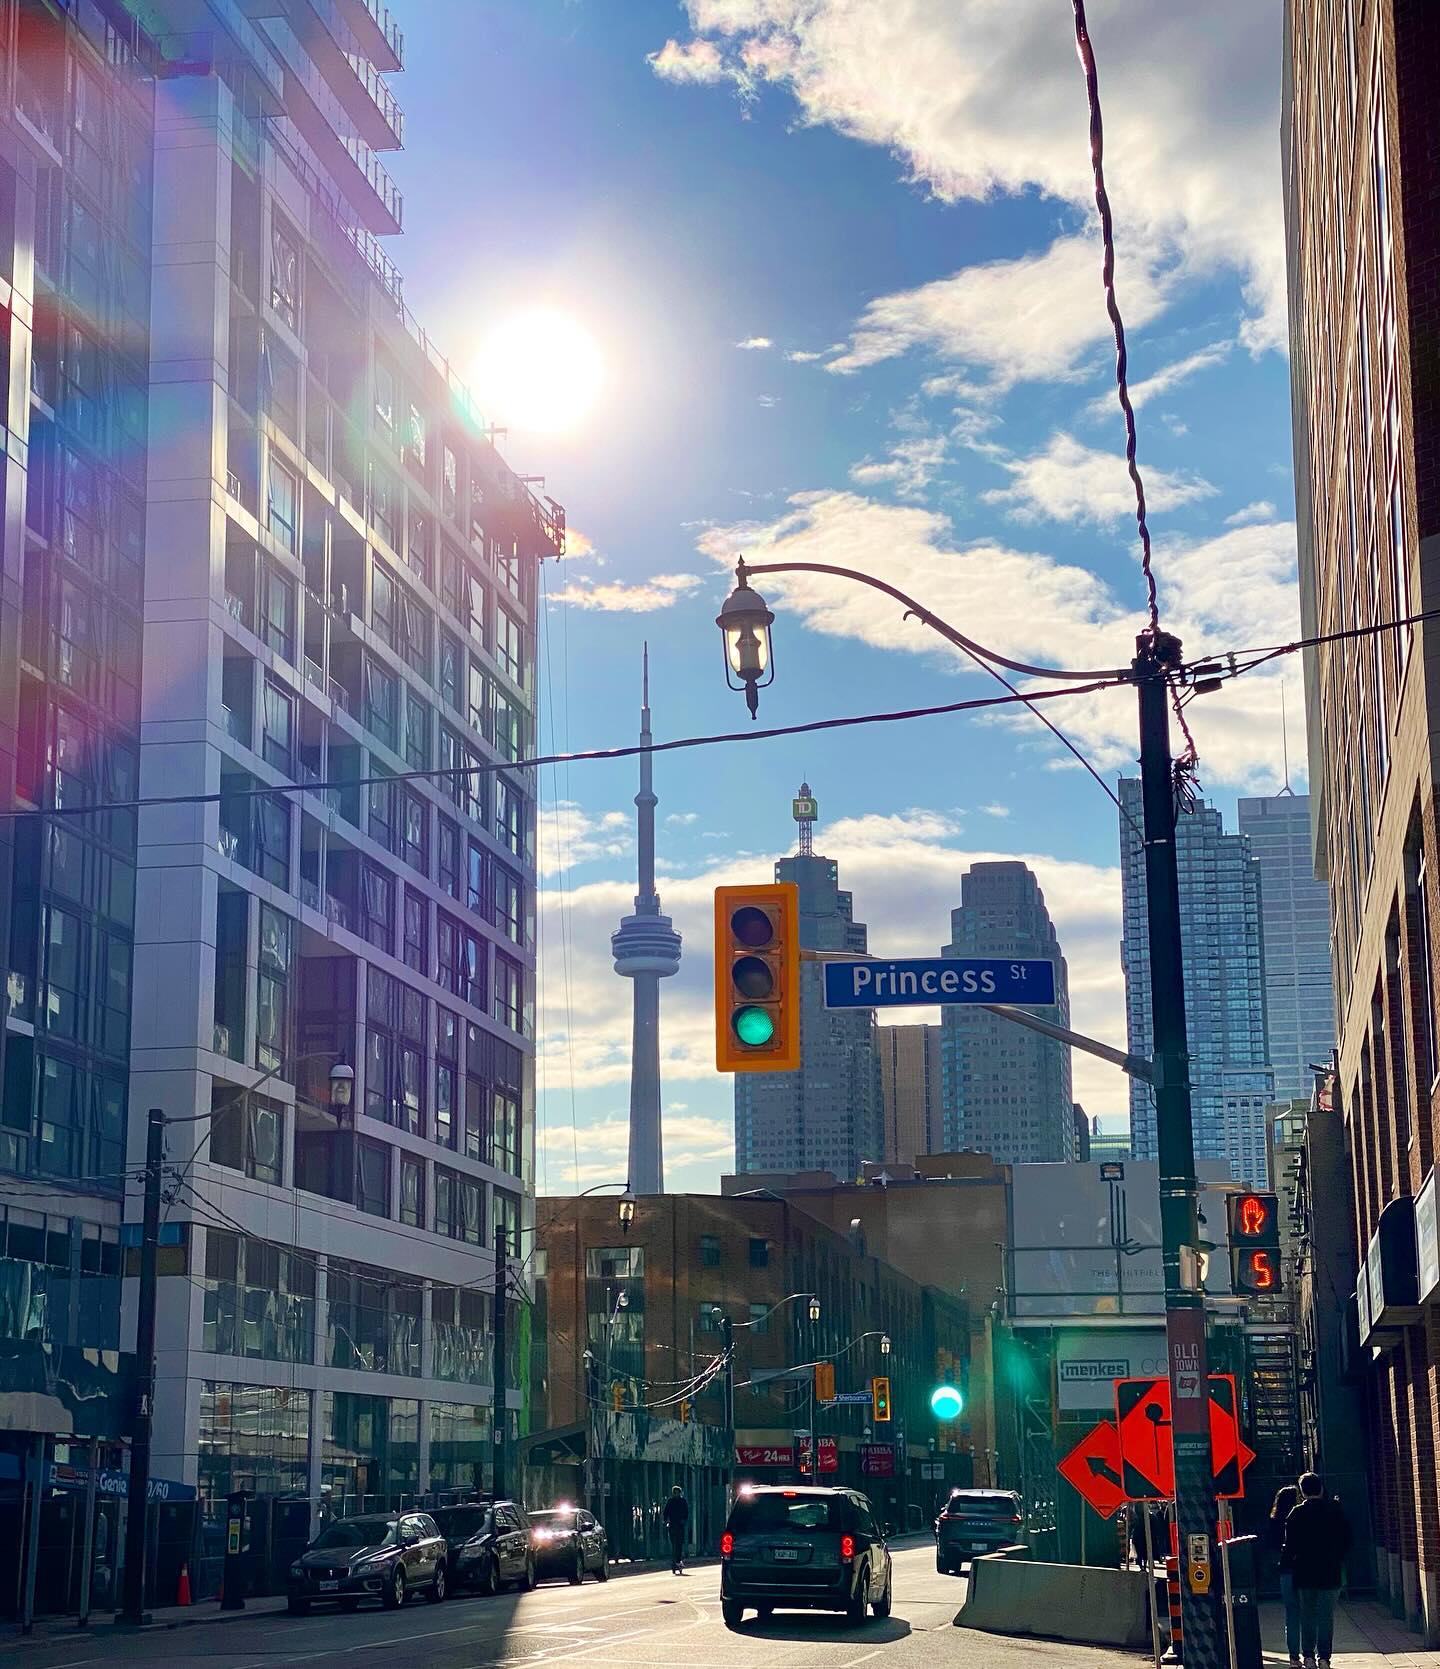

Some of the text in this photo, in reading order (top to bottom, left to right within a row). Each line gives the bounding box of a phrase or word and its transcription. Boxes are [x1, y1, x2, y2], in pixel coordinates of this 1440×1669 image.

[795, 802, 811, 813] TD
[853, 964, 1027, 996] Princess St
[1254, 1252, 1271, 1287] 5
[1174, 1343, 1198, 1358] OLD
[1065, 1363, 1125, 1376] menkes
[1175, 1360, 1199, 1371] TOWN
[100, 1473, 127, 1493] Genie
